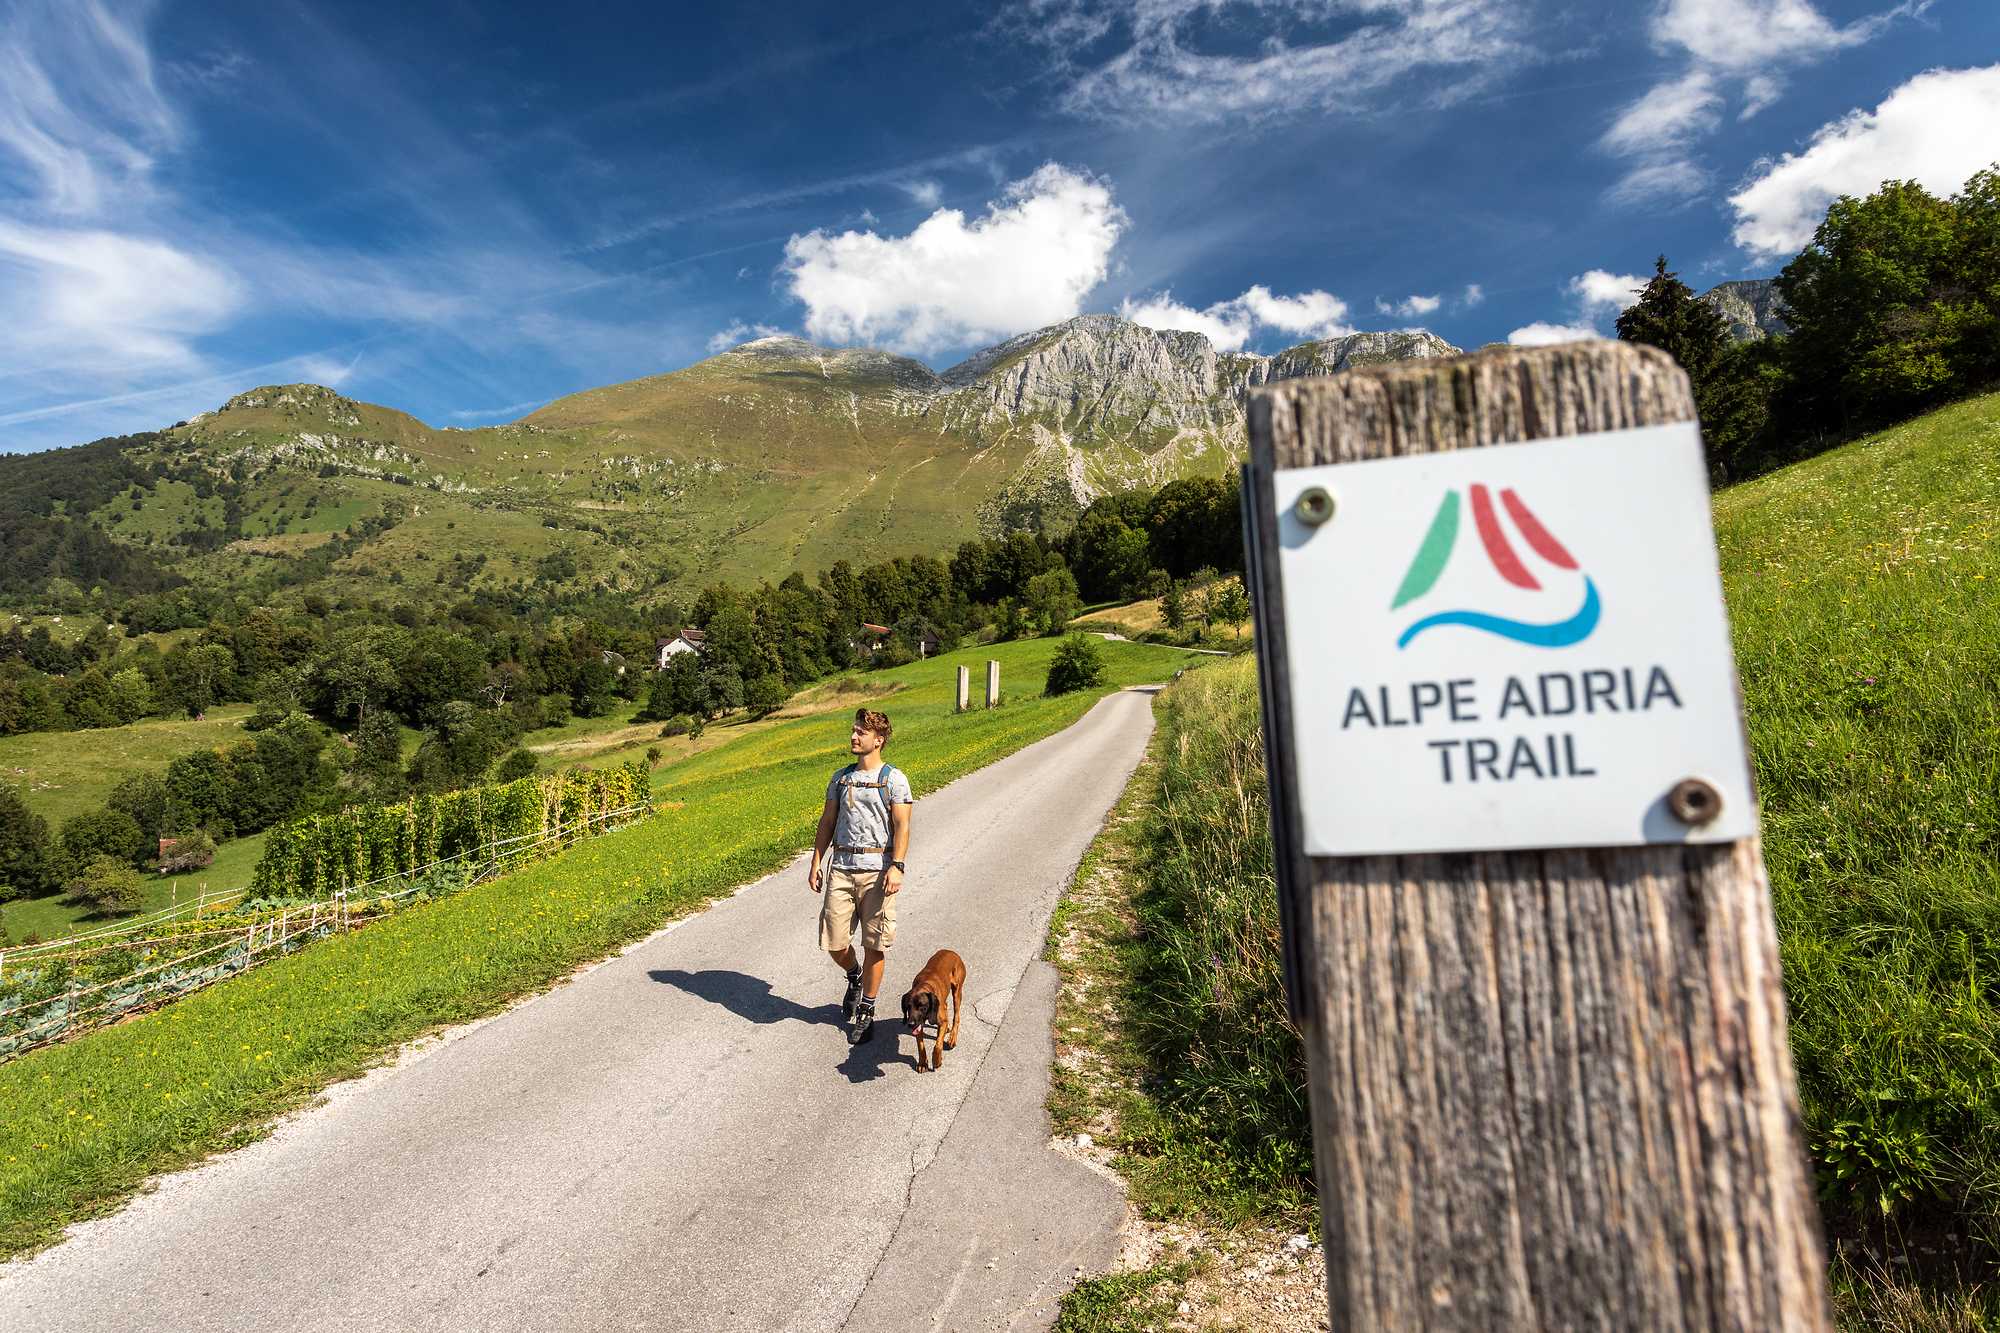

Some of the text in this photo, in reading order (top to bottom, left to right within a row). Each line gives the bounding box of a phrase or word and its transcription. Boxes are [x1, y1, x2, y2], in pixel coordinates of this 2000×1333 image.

[1342, 666, 1683, 729] ALPE ADRIA
[1428, 733, 1597, 783] TRAIL
